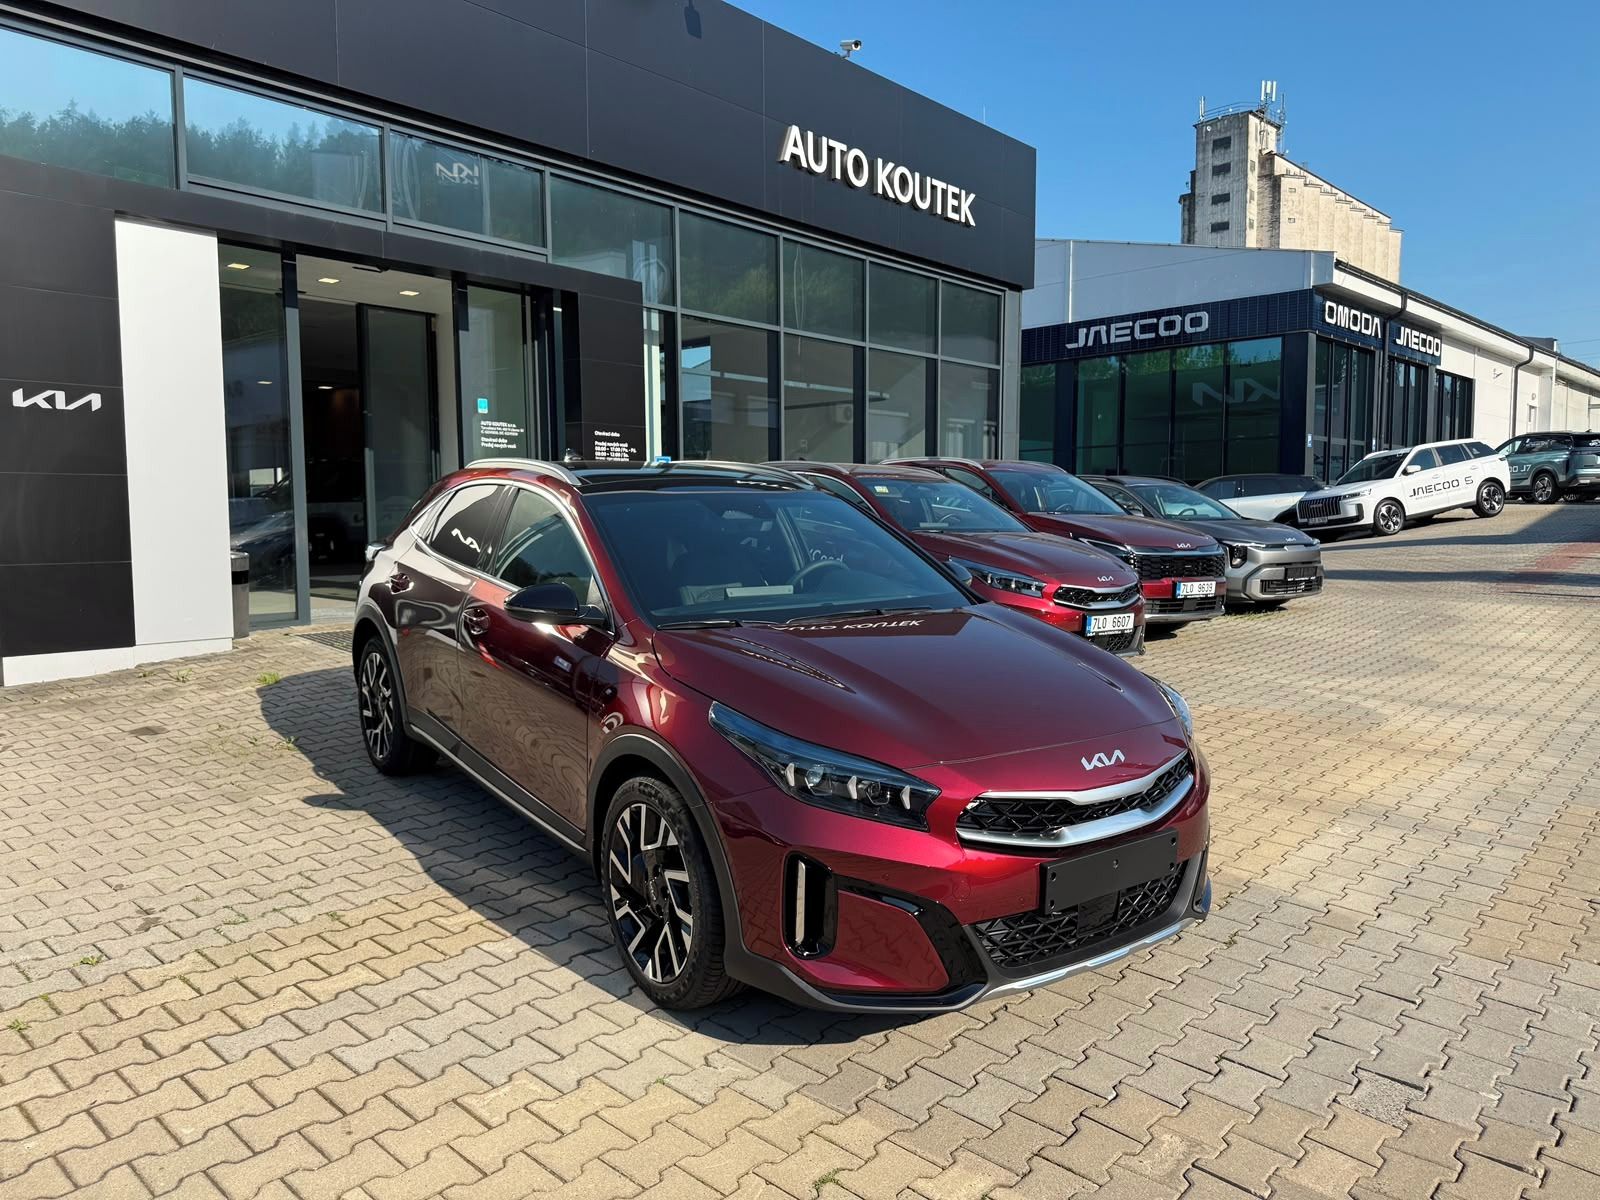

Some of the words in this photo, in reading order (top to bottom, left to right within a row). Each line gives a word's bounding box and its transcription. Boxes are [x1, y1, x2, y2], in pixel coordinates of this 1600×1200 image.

[778, 124, 869, 188] AUTO
[874, 157, 976, 227] KOUTEK
[1065, 311, 1209, 350] JAECOO
[1324, 300, 1382, 339] OMODA
[1396, 325, 1441, 357] JAECOO
[12, 388, 102, 412] KIA
[1408, 478, 1460, 498] JAECOO
[1112, 615, 1131, 628] 6607
[1080, 749, 1126, 771] KIA
